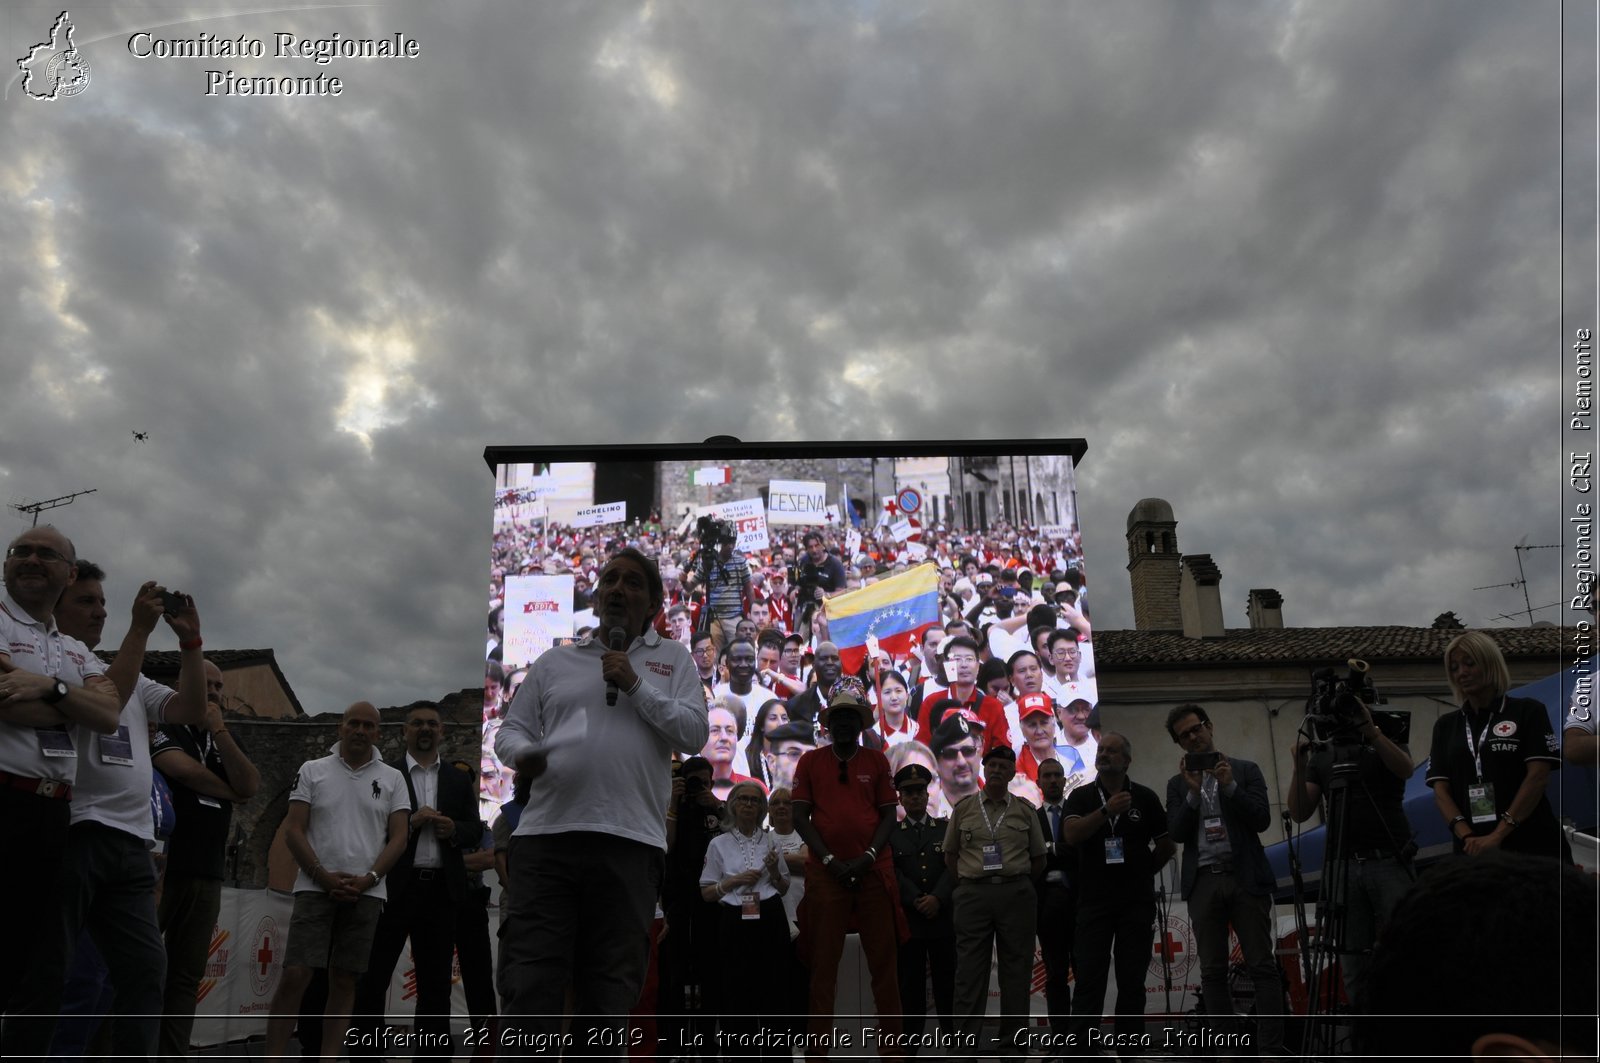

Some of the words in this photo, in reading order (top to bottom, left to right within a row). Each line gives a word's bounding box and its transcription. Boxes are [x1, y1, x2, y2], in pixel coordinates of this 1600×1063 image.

[770, 493, 824, 512] CESENA
[577, 505, 621, 516] NICHELINO
[744, 533, 763, 543] 2019
[1491, 743, 1518, 752] STAFF
